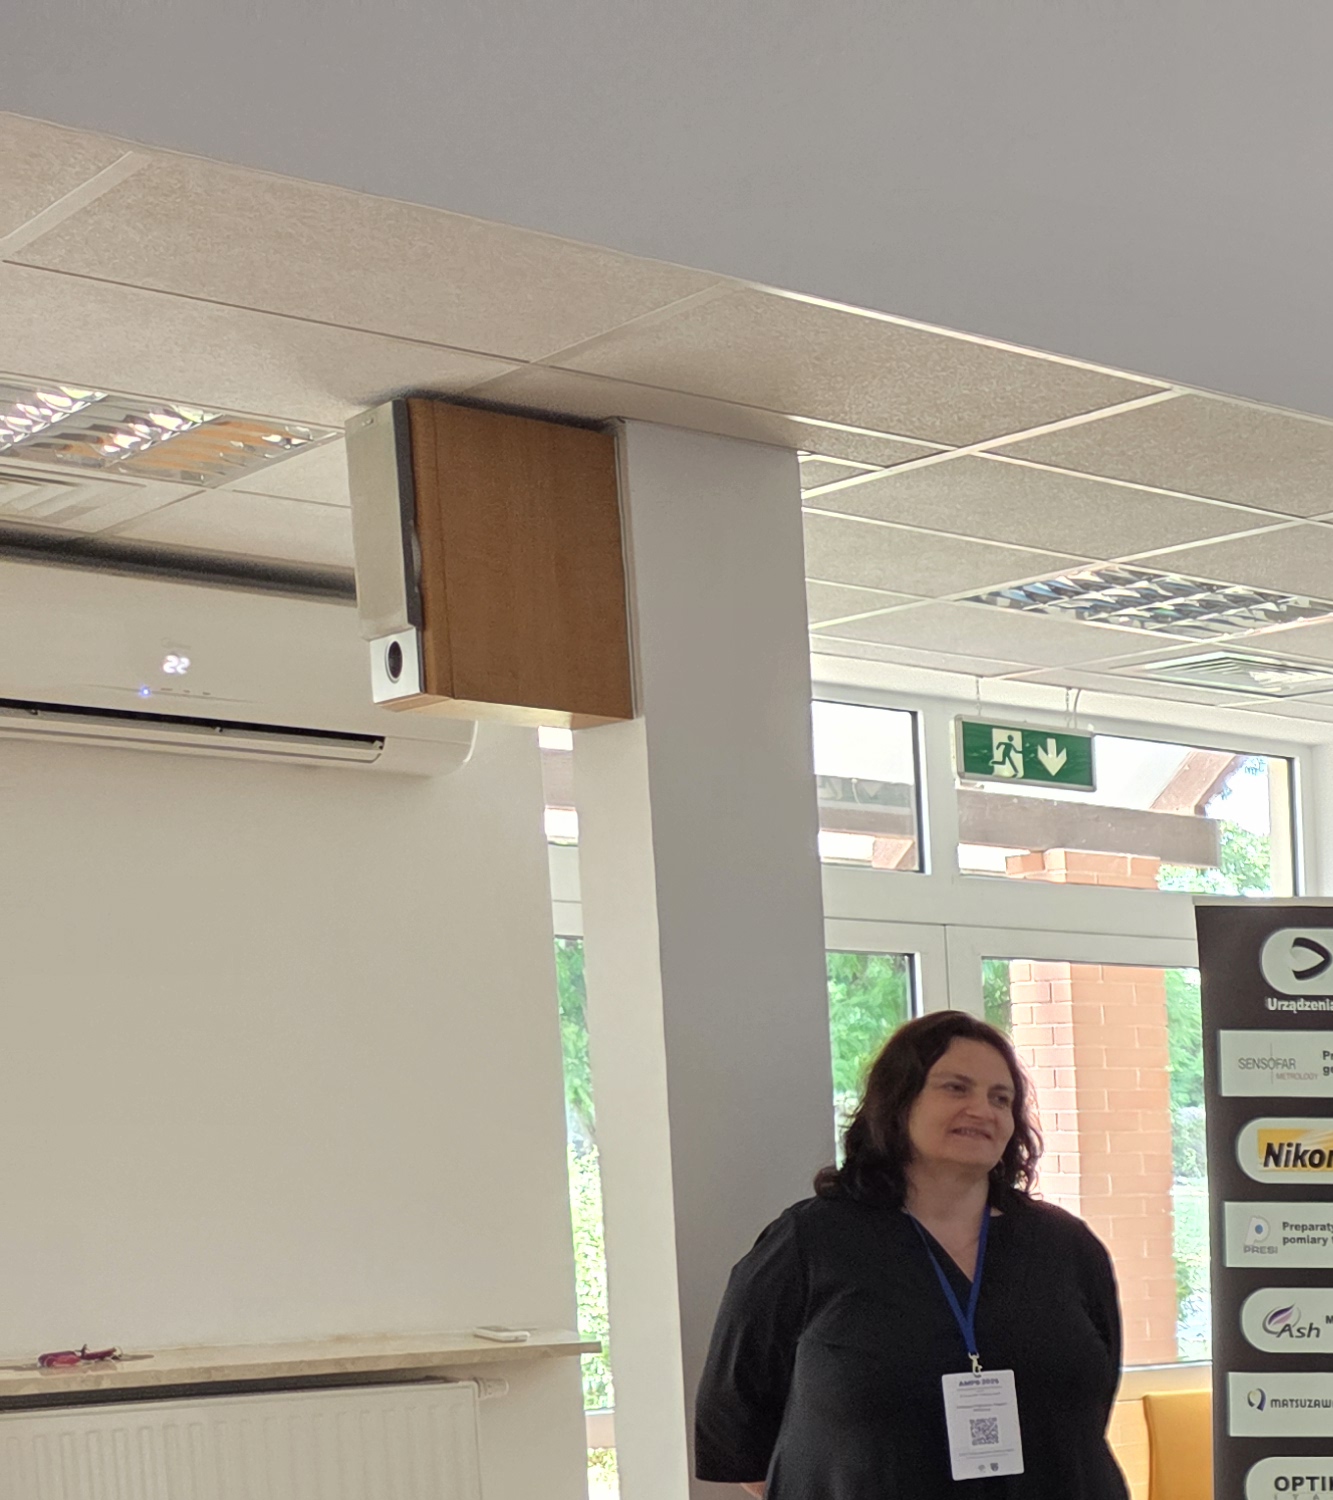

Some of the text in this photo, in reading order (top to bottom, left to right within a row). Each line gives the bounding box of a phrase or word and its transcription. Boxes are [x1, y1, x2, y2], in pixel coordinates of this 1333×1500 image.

[1238, 1057, 1297, 1070] SENSOFAR
[1282, 1235, 1329, 1247] pomiary
[1275, 1322, 1321, 1339] Ash
